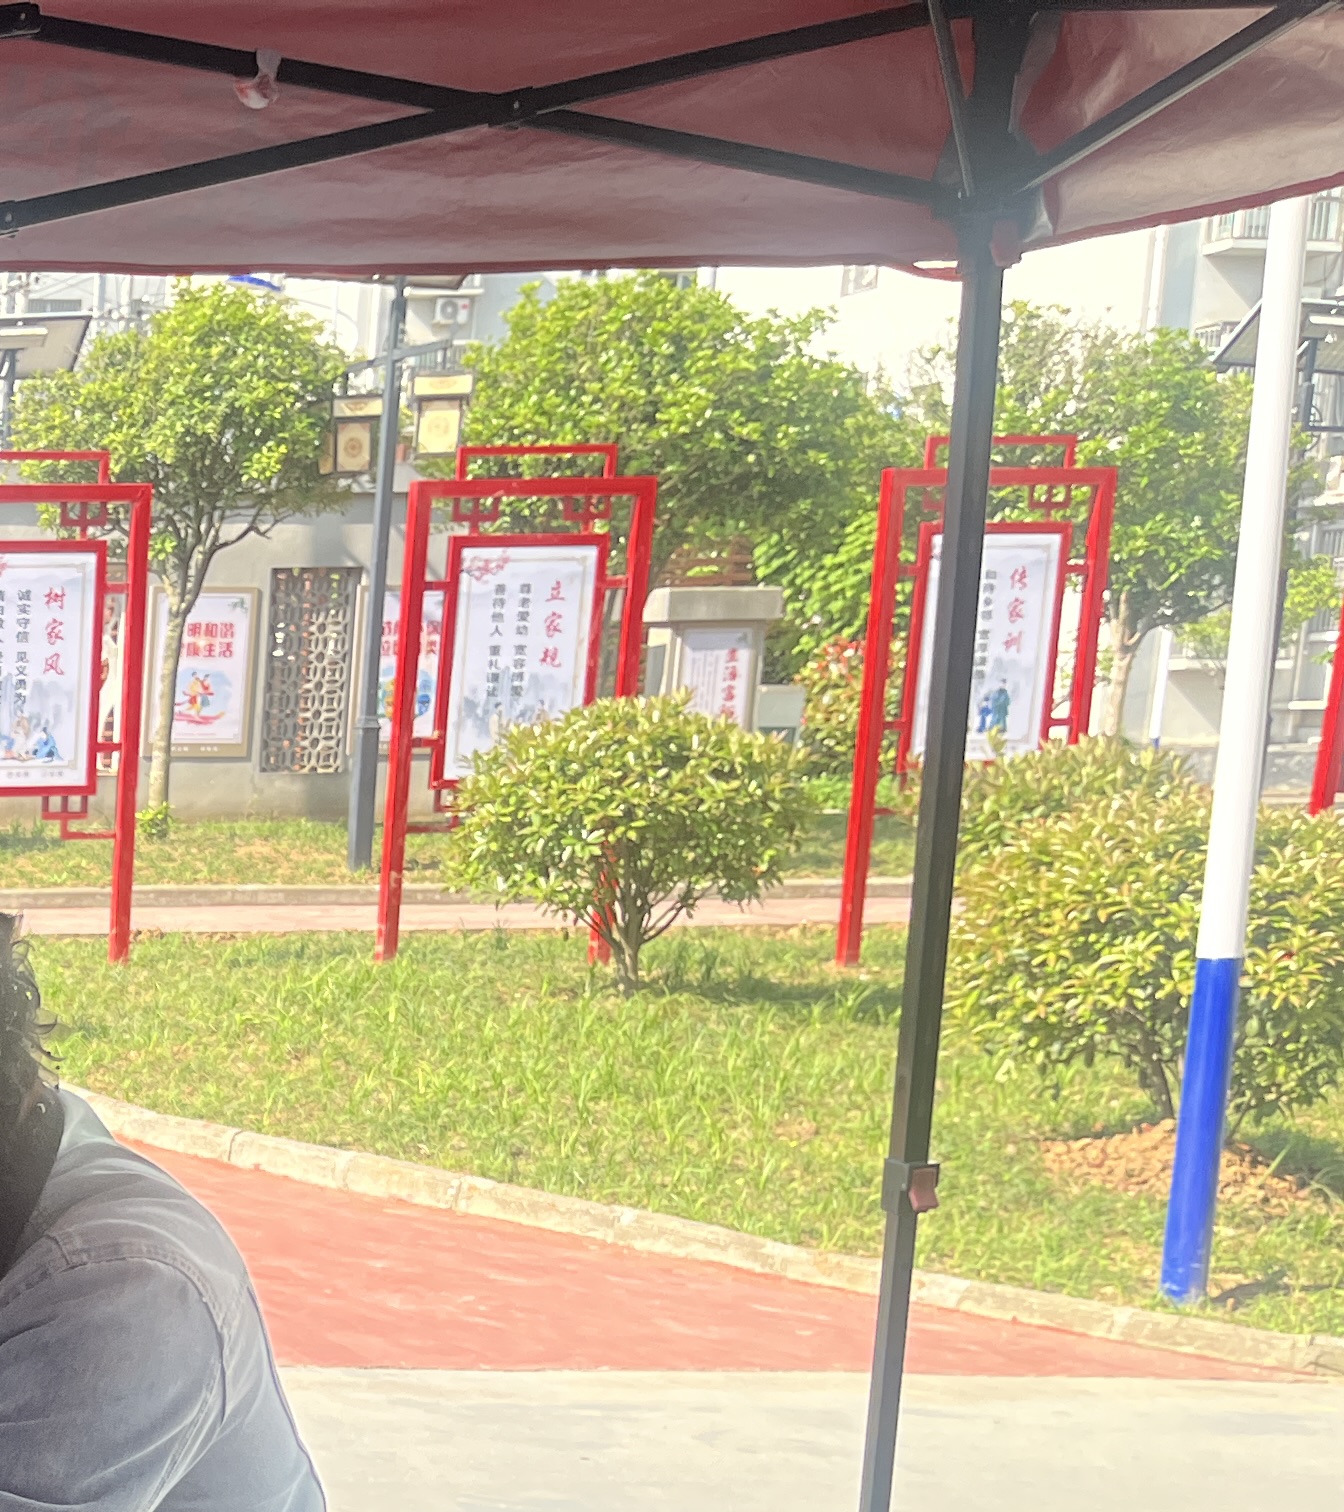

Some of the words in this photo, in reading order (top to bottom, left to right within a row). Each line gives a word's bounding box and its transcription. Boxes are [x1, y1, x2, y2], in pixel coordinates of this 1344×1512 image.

[16, 589, 32, 644] 诚实守信
[43, 586, 66, 676] 树家风
[539, 580, 565, 668] 立家规
[1003, 565, 1028, 654] 传家训
[13, 651, 30, 706] 见义勇为
